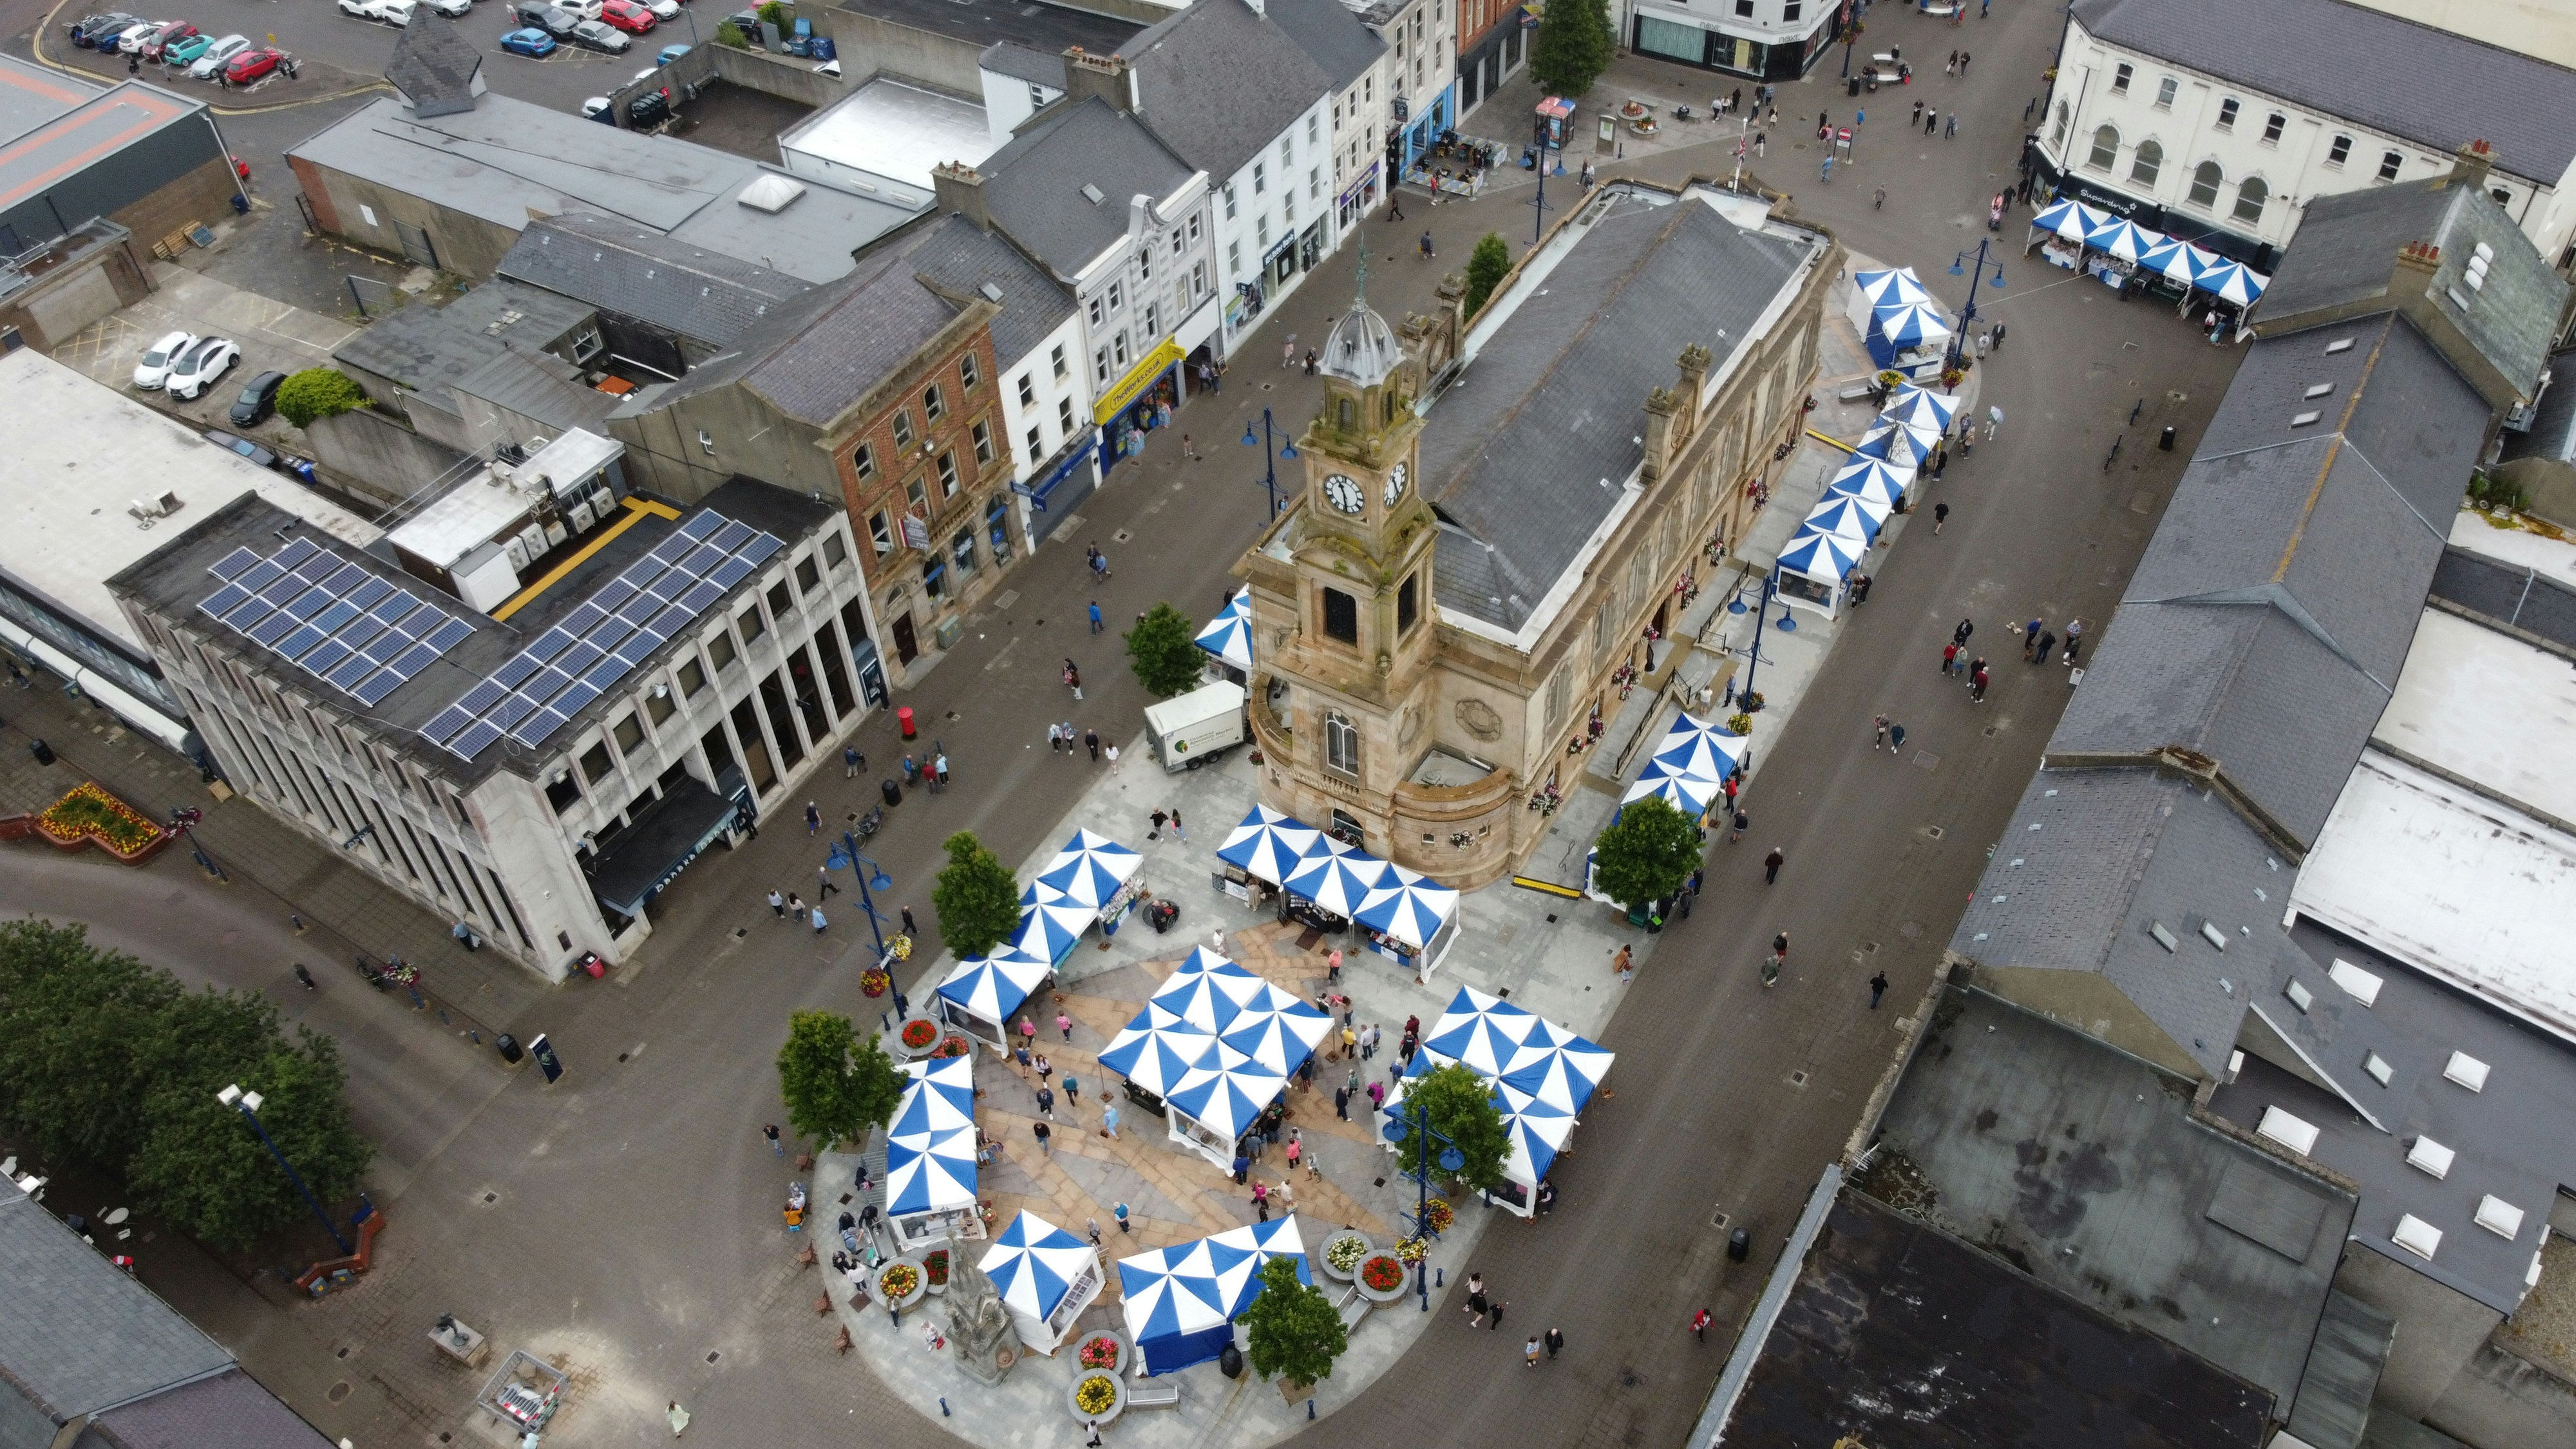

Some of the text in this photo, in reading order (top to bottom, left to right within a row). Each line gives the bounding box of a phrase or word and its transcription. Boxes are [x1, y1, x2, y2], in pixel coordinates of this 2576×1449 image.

[1700, 21, 1721, 32] next
[1779, 34, 1801, 43] next
[2080, 189, 2130, 214] Superdrug
[1270, 233, 1294, 261] Ulster Bank
[1112, 358, 1161, 405] TheWorks.co.uk
